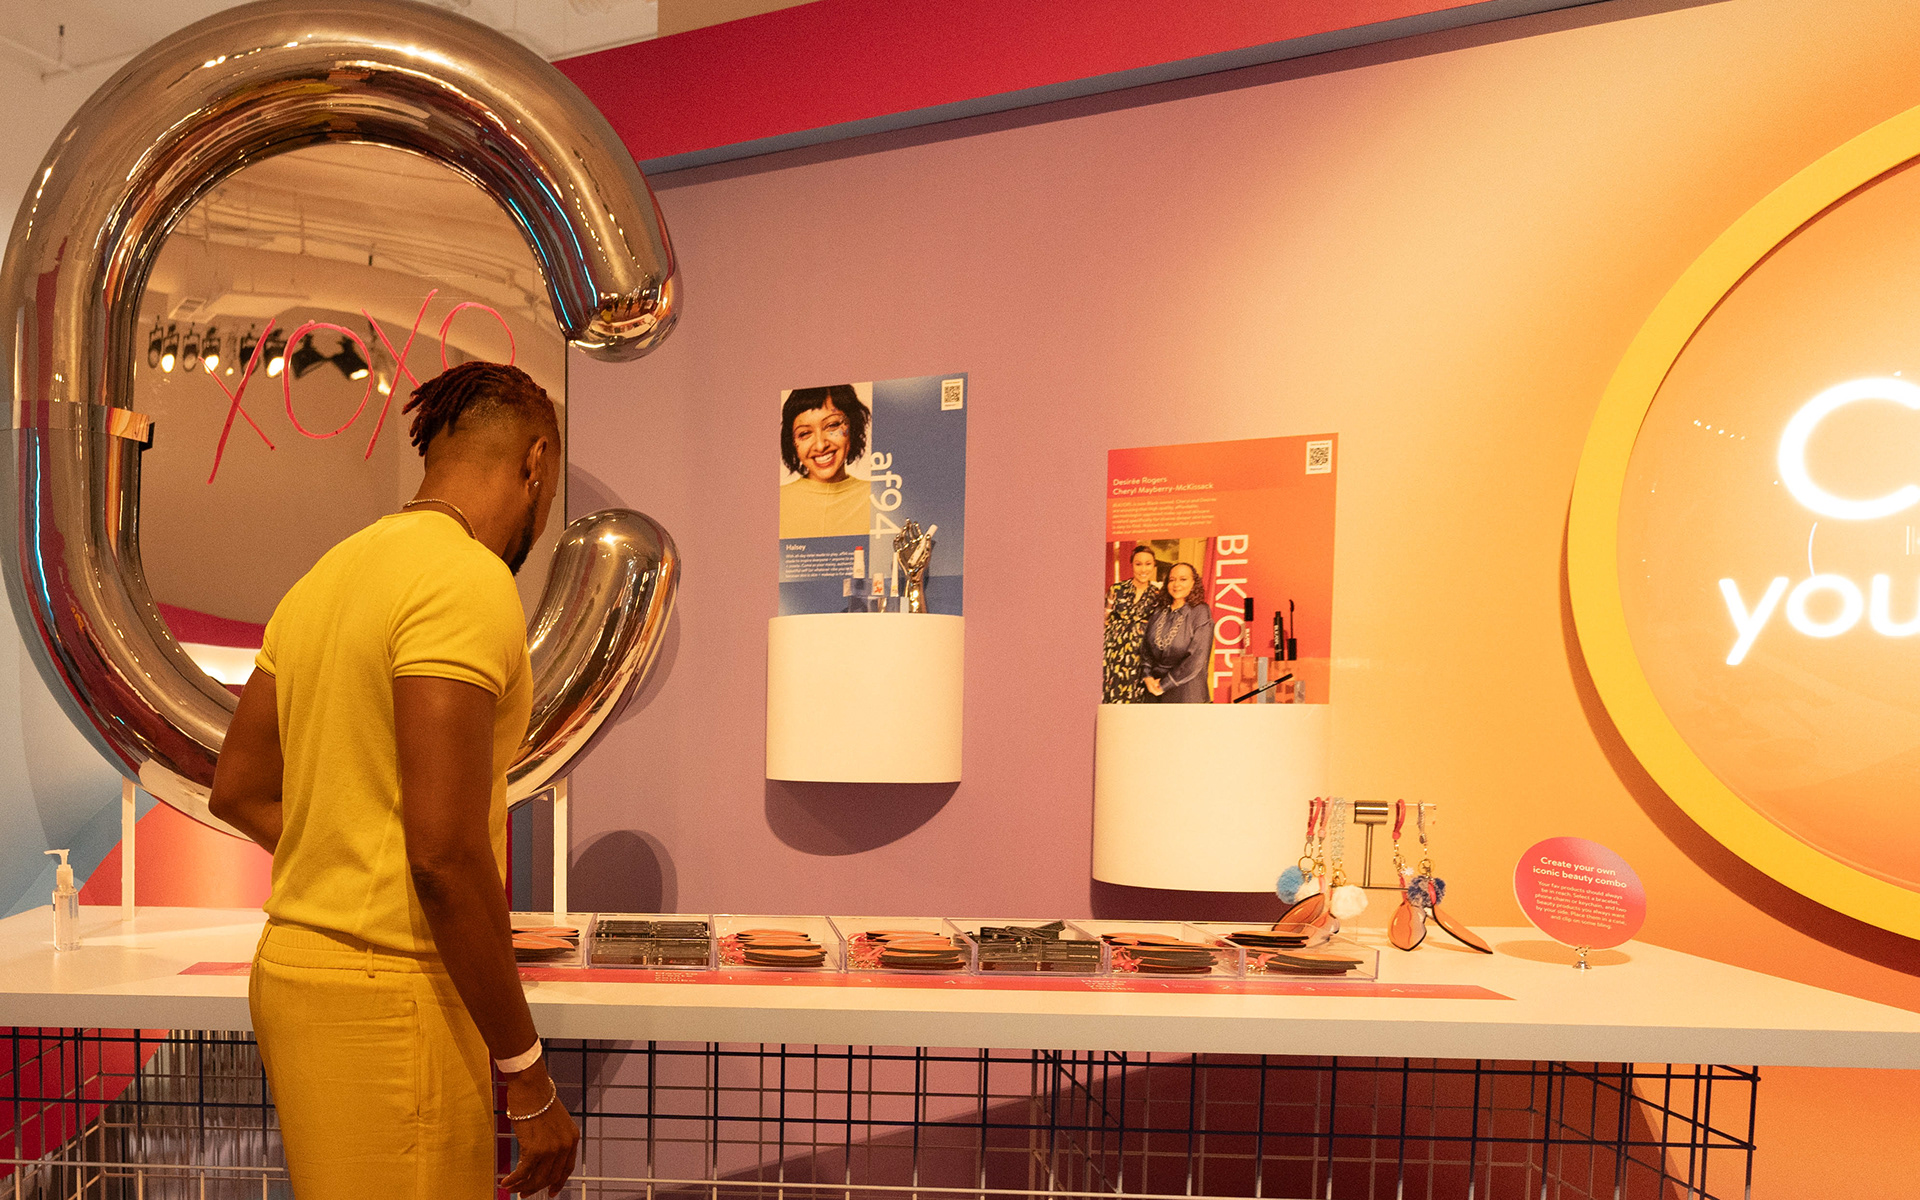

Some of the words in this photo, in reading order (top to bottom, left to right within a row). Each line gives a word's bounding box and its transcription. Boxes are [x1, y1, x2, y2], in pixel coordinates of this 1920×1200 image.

[1142, 477, 1167, 485] Rogers
[1138, 482, 1214, 494] Mayberry-McKissack
[869, 451, 902, 539] af94
[1540, 857, 1572, 868] Create
[1597, 868, 1616, 876] own
[1533, 866, 1560, 877] iconic
[1562, 871, 1593, 884] beauty
[1595, 878, 1627, 888] combo
[1561, 884, 1585, 893] products
[1556, 902, 1580, 911] products
